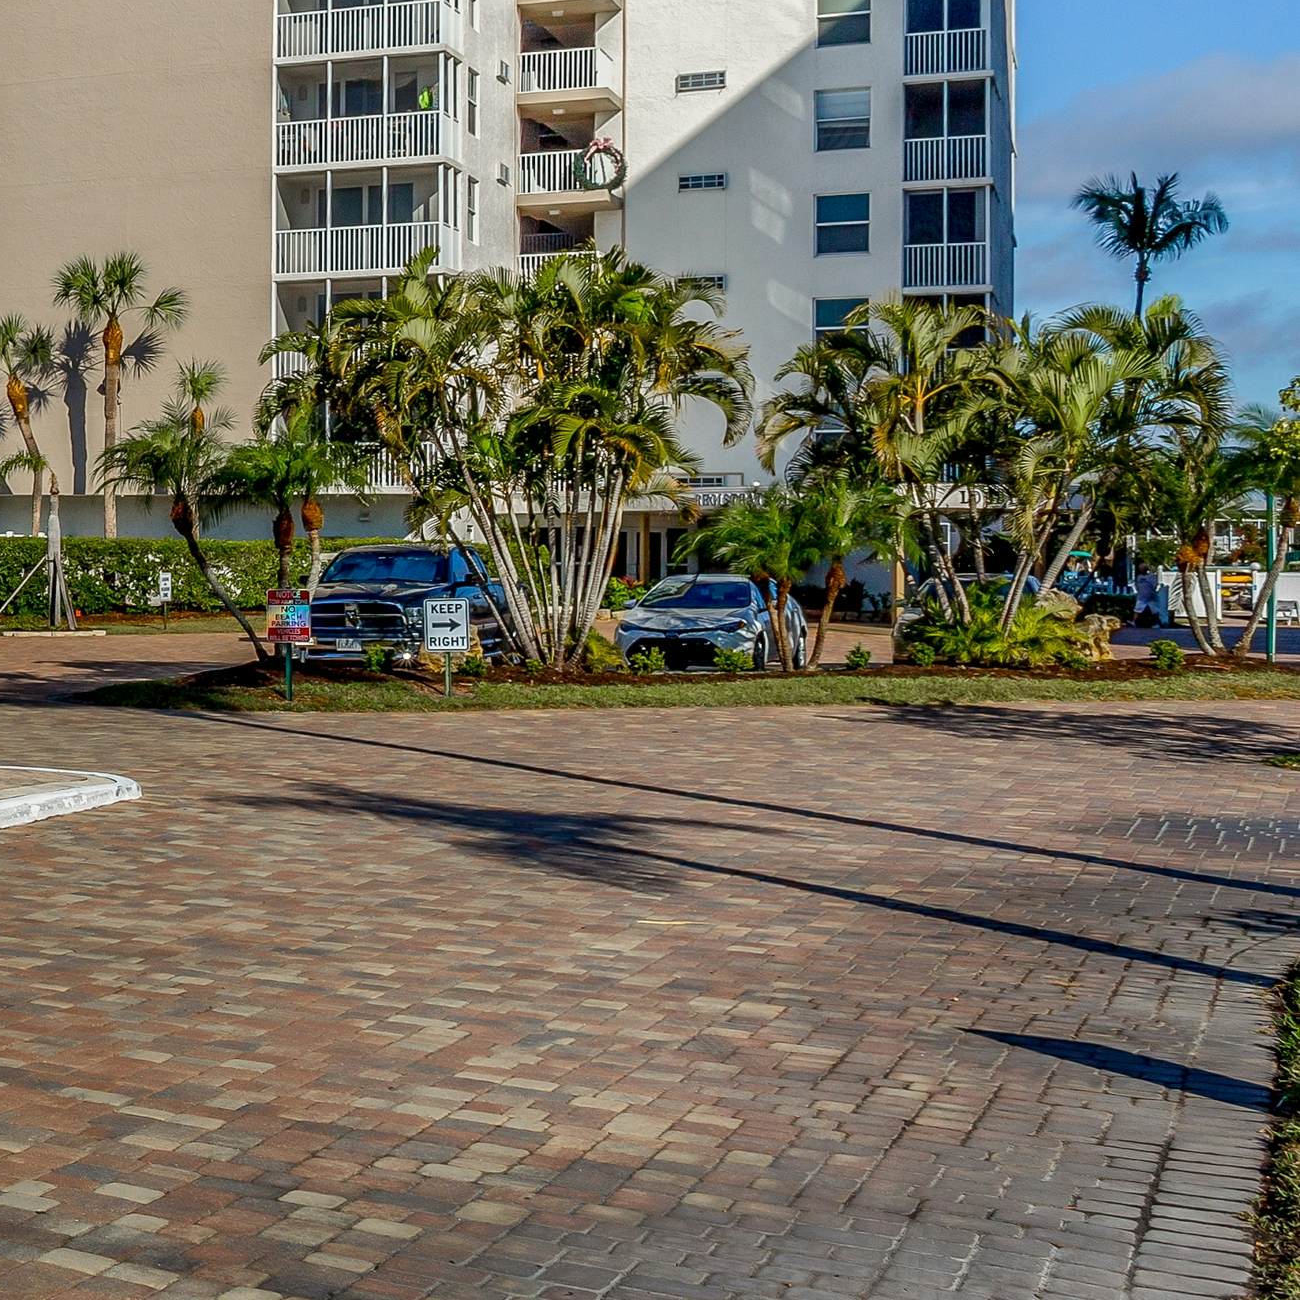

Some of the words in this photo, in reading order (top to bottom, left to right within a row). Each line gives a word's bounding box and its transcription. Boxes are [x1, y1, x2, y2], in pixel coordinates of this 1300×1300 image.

[276, 590, 301, 599] NOTICE
[280, 605, 296, 613] NO
[431, 603, 463, 614] KEEP
[429, 636, 466, 647] RIGHT
